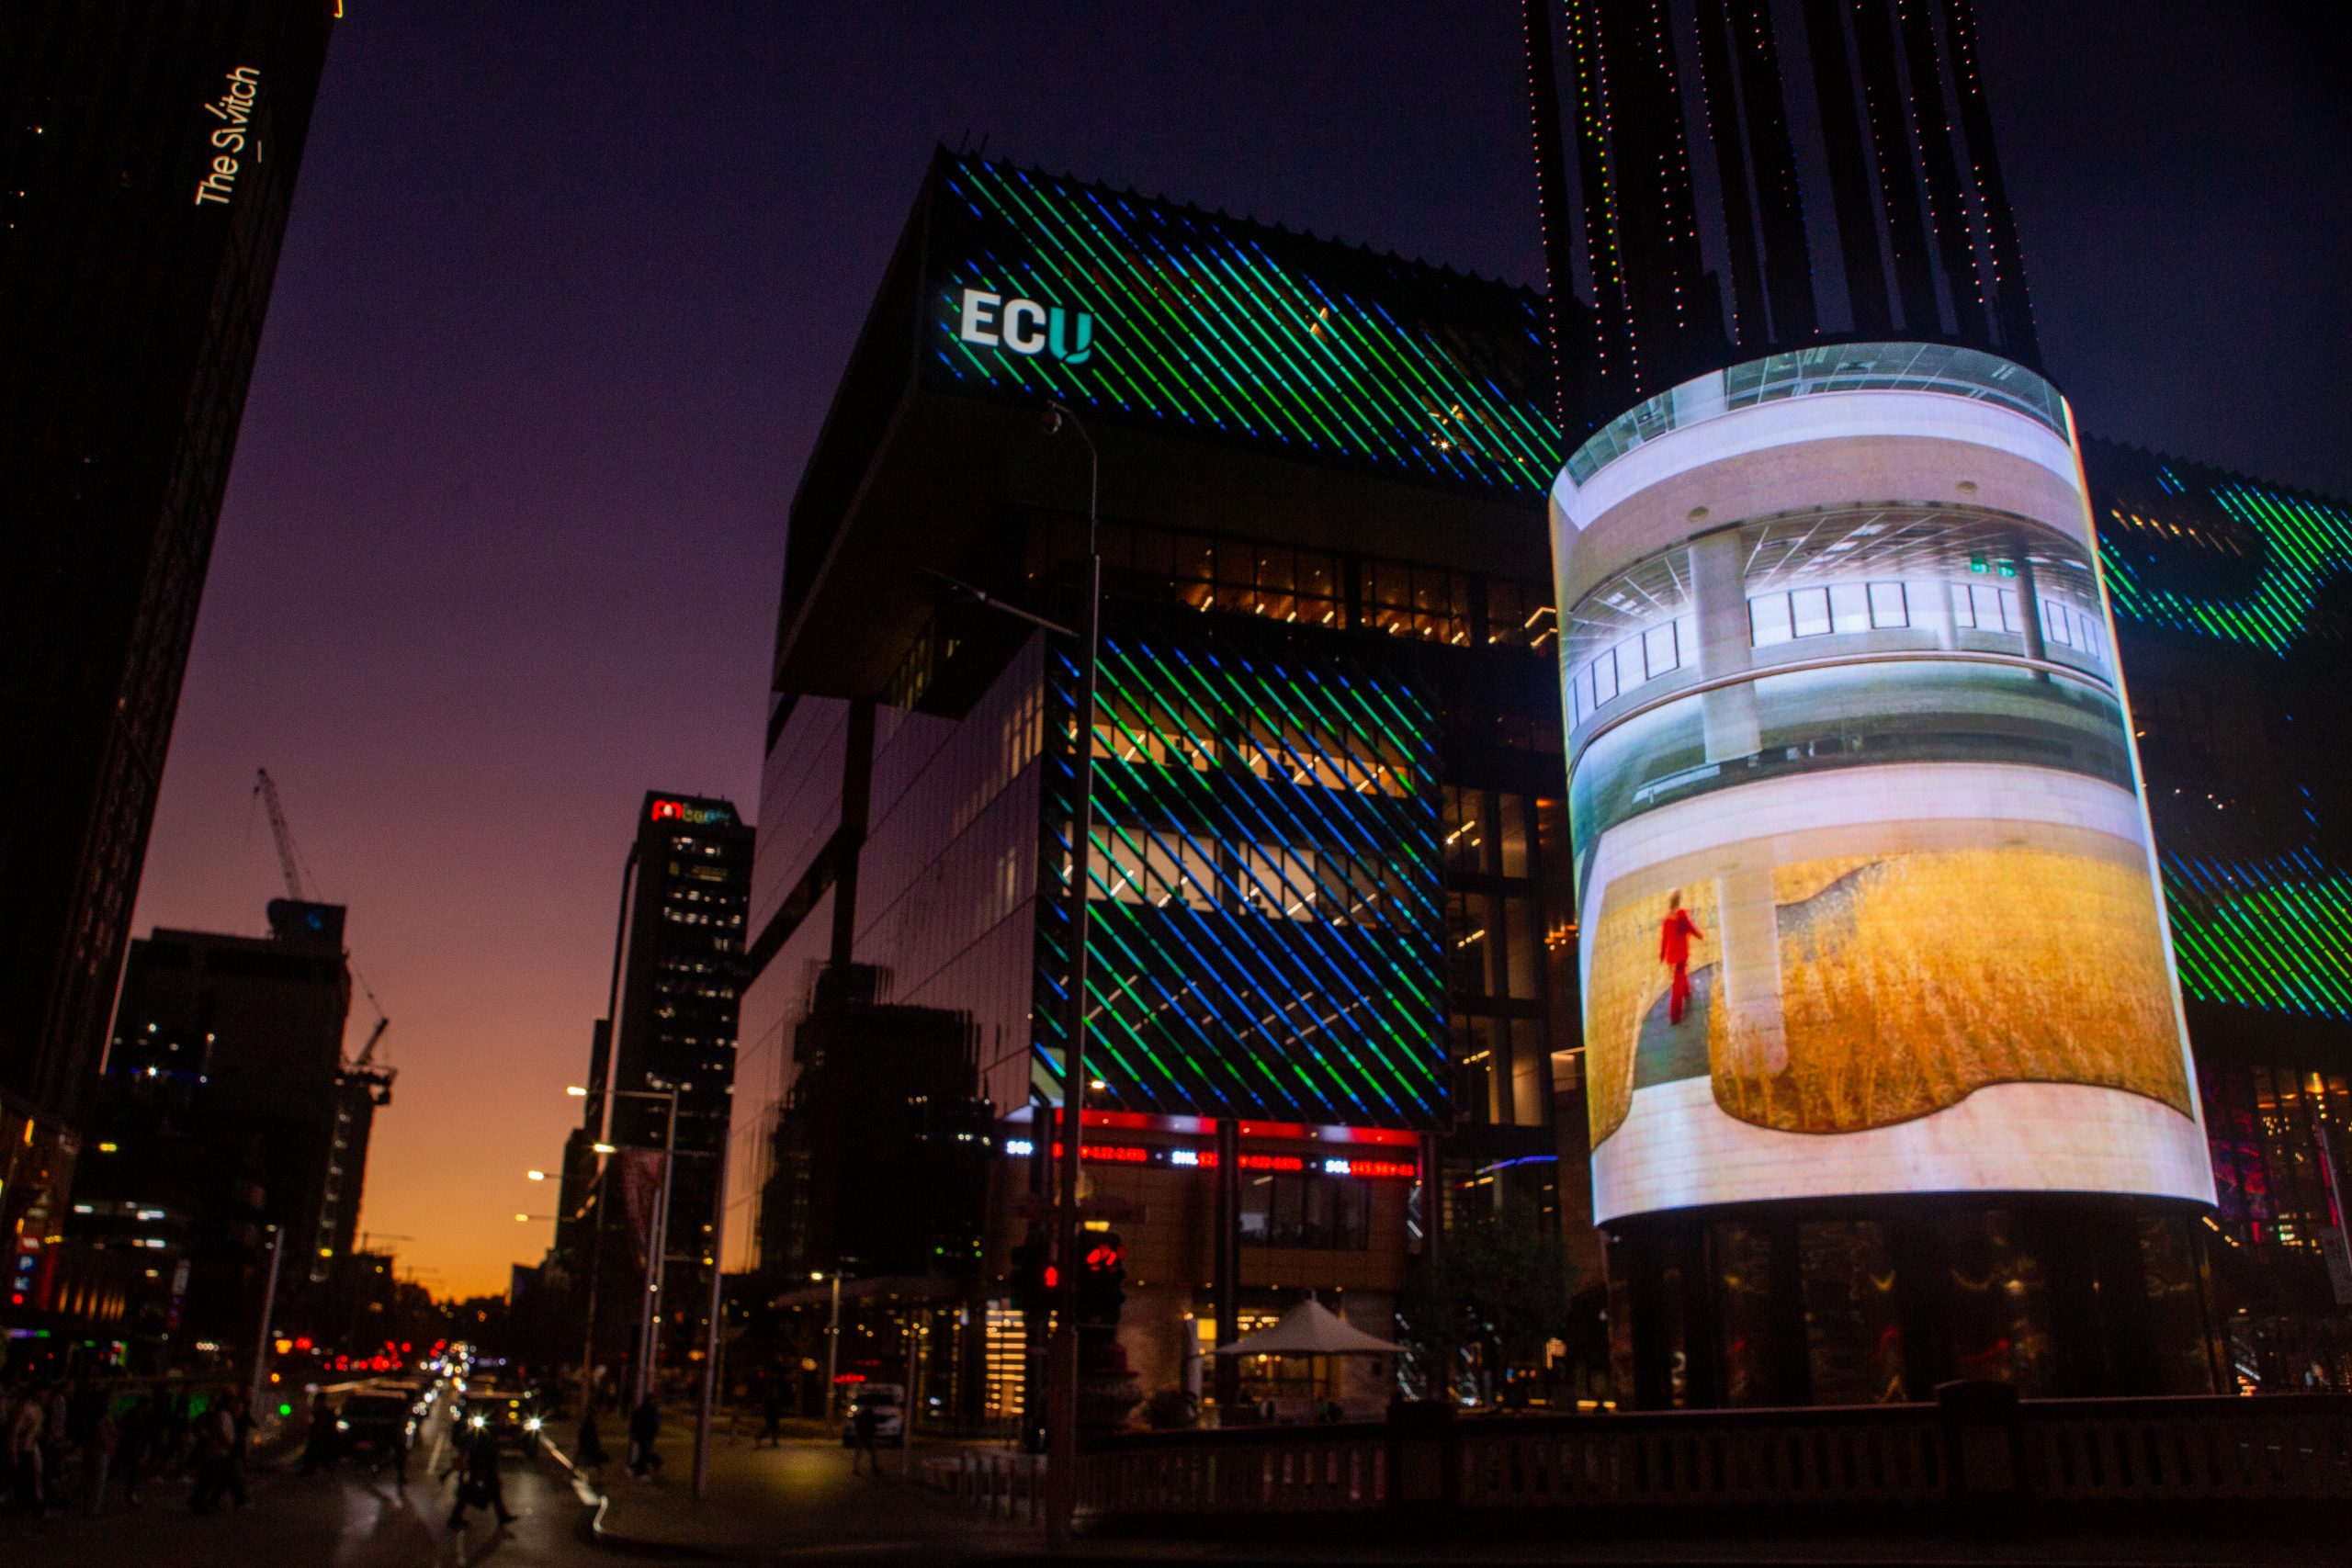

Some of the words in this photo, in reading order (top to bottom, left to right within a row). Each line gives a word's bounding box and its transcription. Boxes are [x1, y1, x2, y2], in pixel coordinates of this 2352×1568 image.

[204, 65, 261, 154] Switch
[194, 154, 240, 206] The
[960, 288, 1148, 365] ECU
